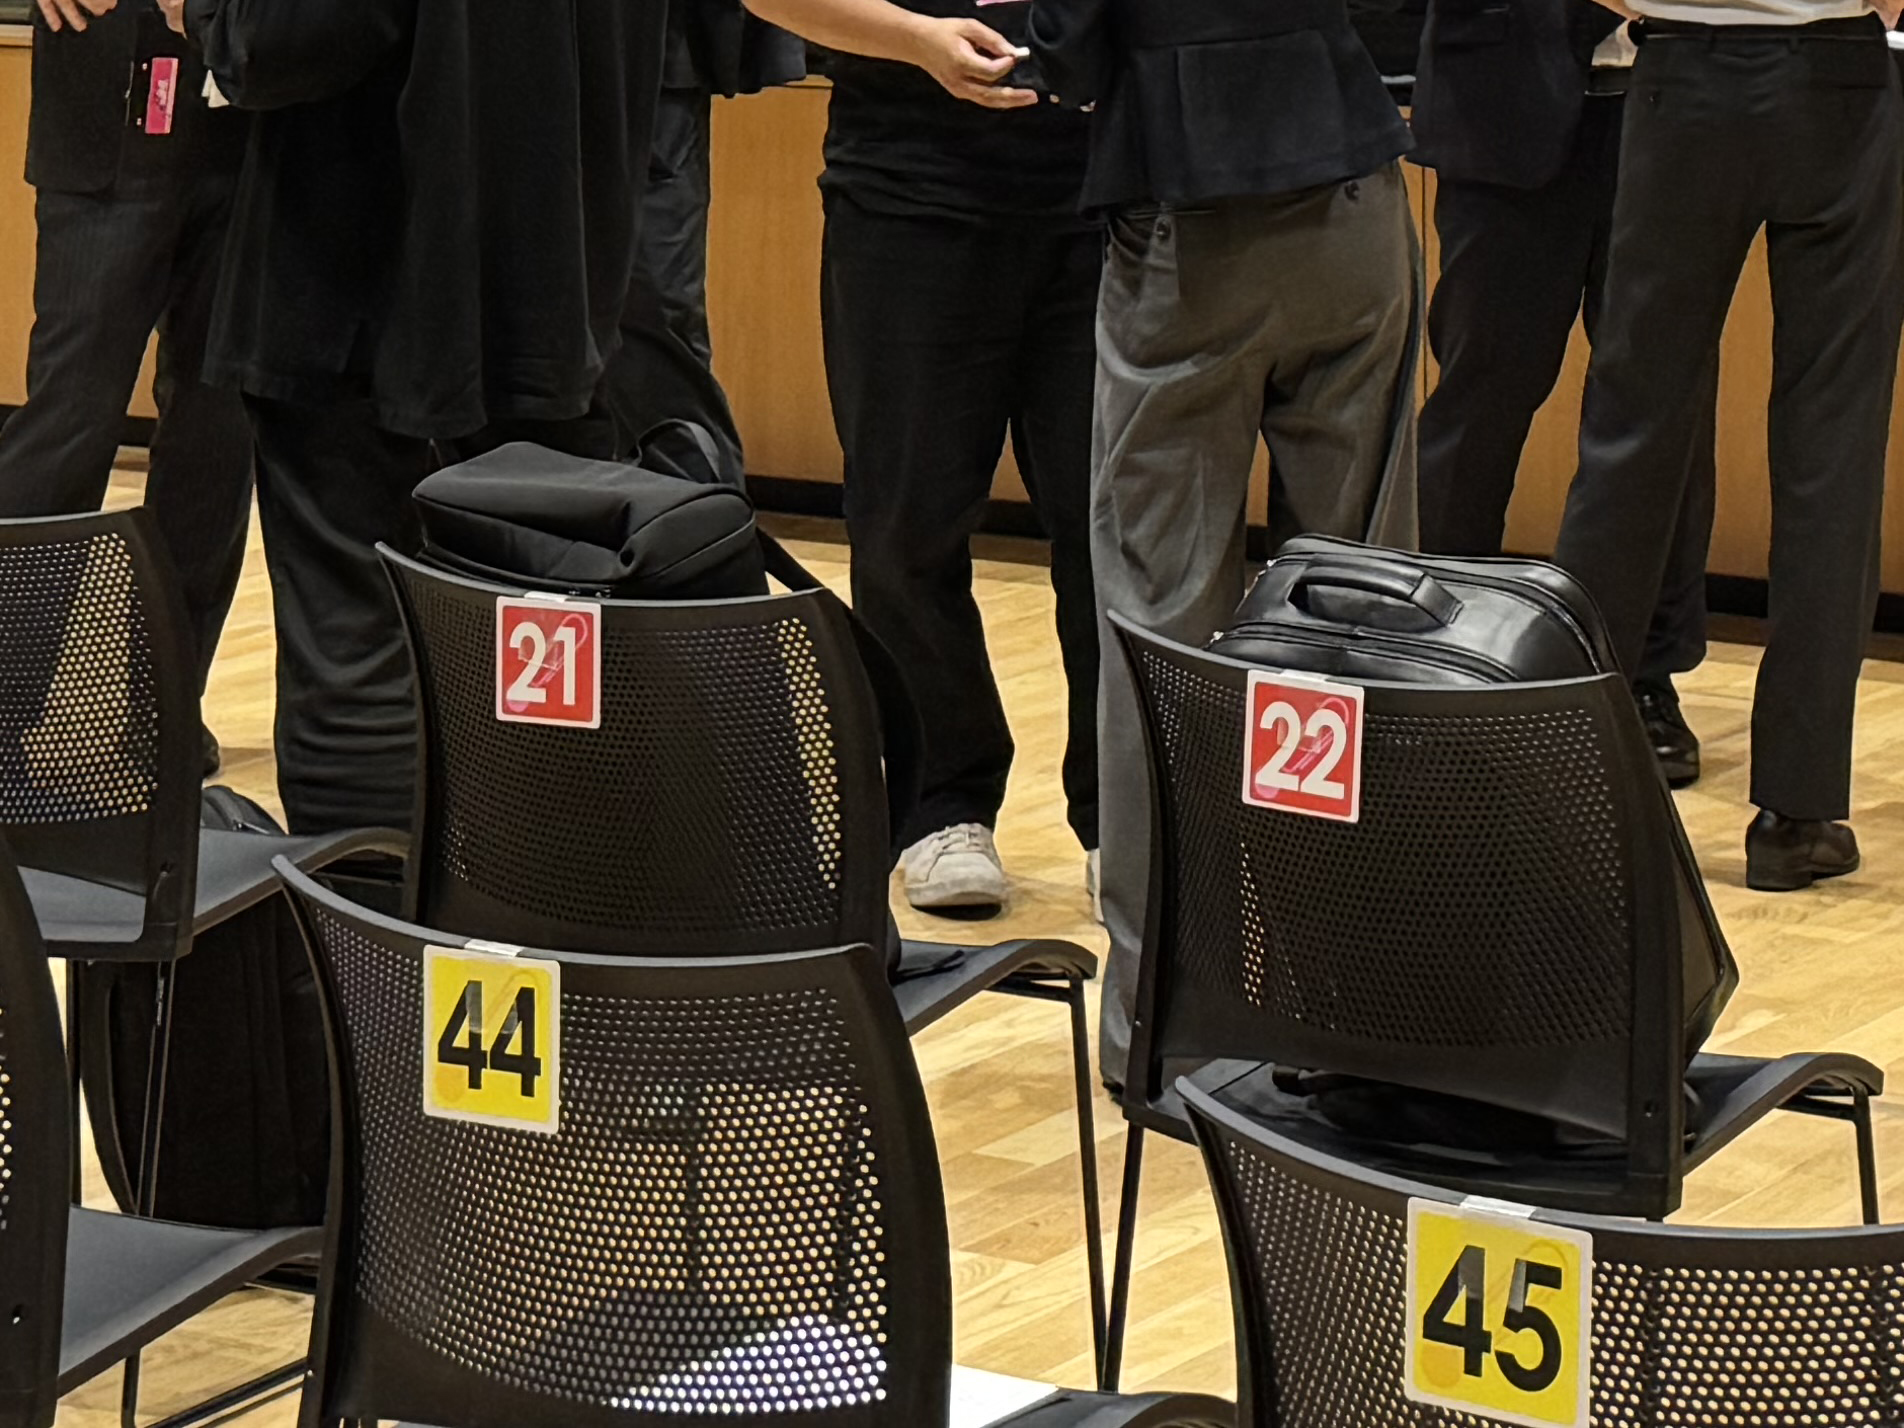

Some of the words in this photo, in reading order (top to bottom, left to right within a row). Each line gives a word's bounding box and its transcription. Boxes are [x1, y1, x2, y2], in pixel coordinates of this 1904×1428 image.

[506, 621, 576, 705] 21
[1255, 701, 1347, 799] 22
[437, 980, 541, 1098] 44
[1422, 1244, 1562, 1392] 45
